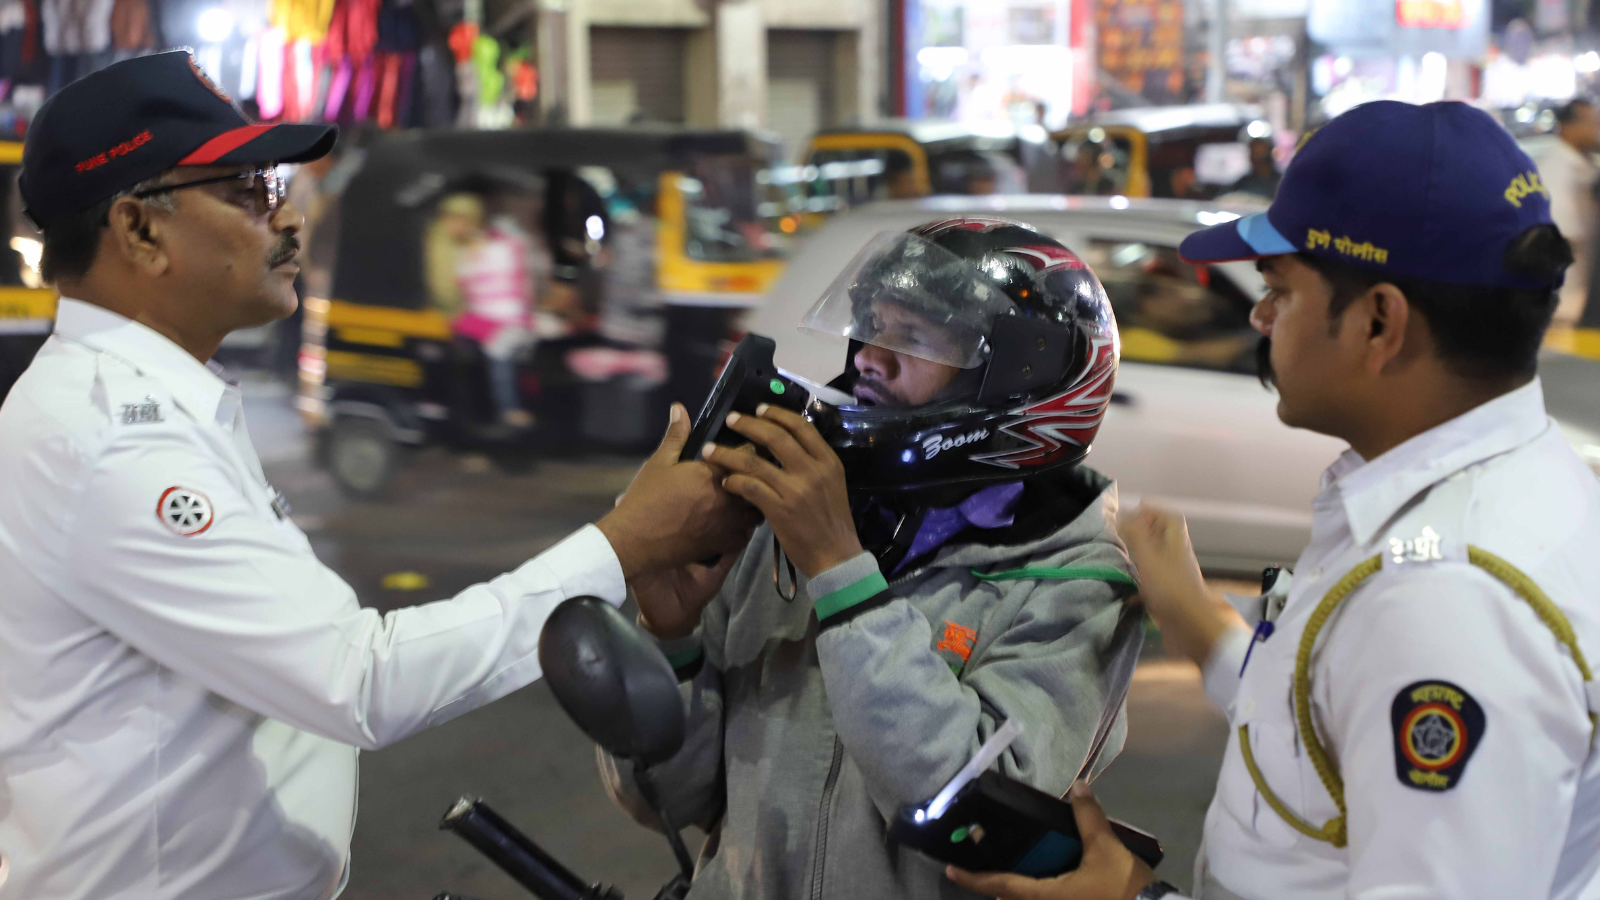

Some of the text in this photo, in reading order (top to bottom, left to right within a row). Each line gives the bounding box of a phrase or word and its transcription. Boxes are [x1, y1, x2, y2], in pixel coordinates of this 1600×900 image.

[109, 129, 154, 159] POLICE
[1305, 228, 1388, 264] पुणे पोलीस
[923, 427, 990, 460] Zoom
